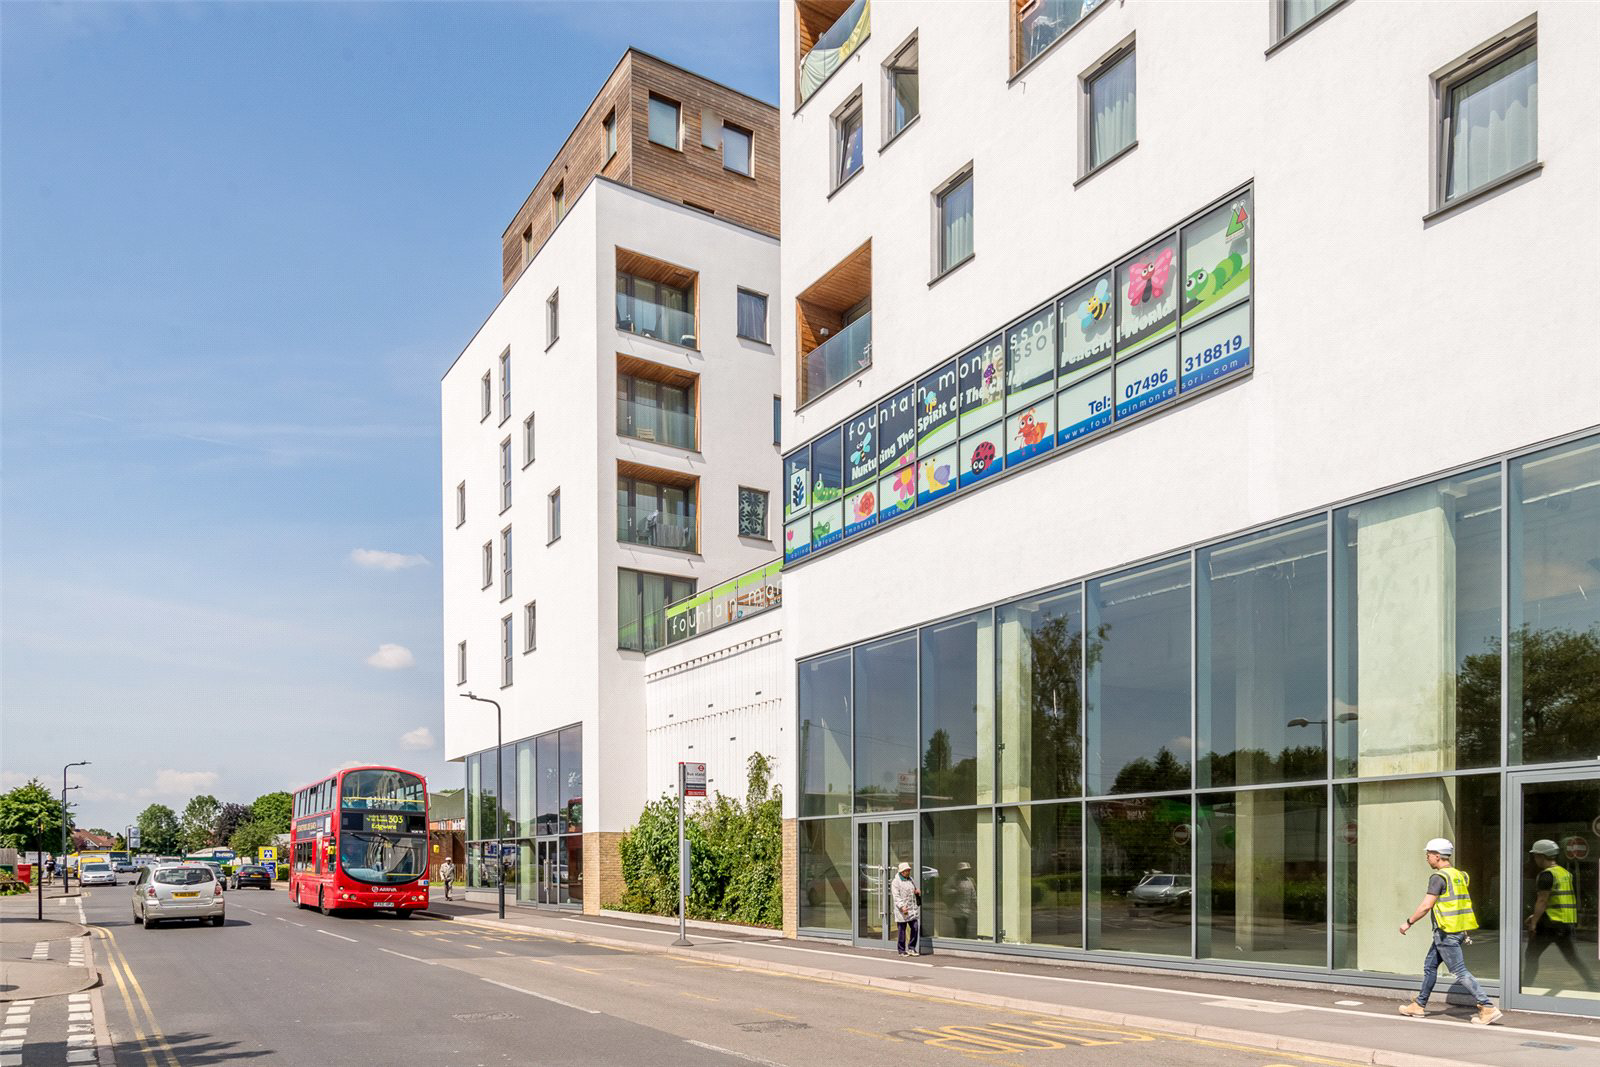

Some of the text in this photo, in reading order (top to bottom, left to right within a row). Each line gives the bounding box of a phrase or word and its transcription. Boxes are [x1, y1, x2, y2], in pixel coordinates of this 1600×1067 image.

[848, 302, 1065, 441] fountain montessori
[1088, 335, 1243, 416] Tel: 07496 318819
[897, 428, 915, 450] The
[965, 385, 985, 405] The
[371, 823, 397, 831] Edgware
[388, 815, 403, 824] 303
